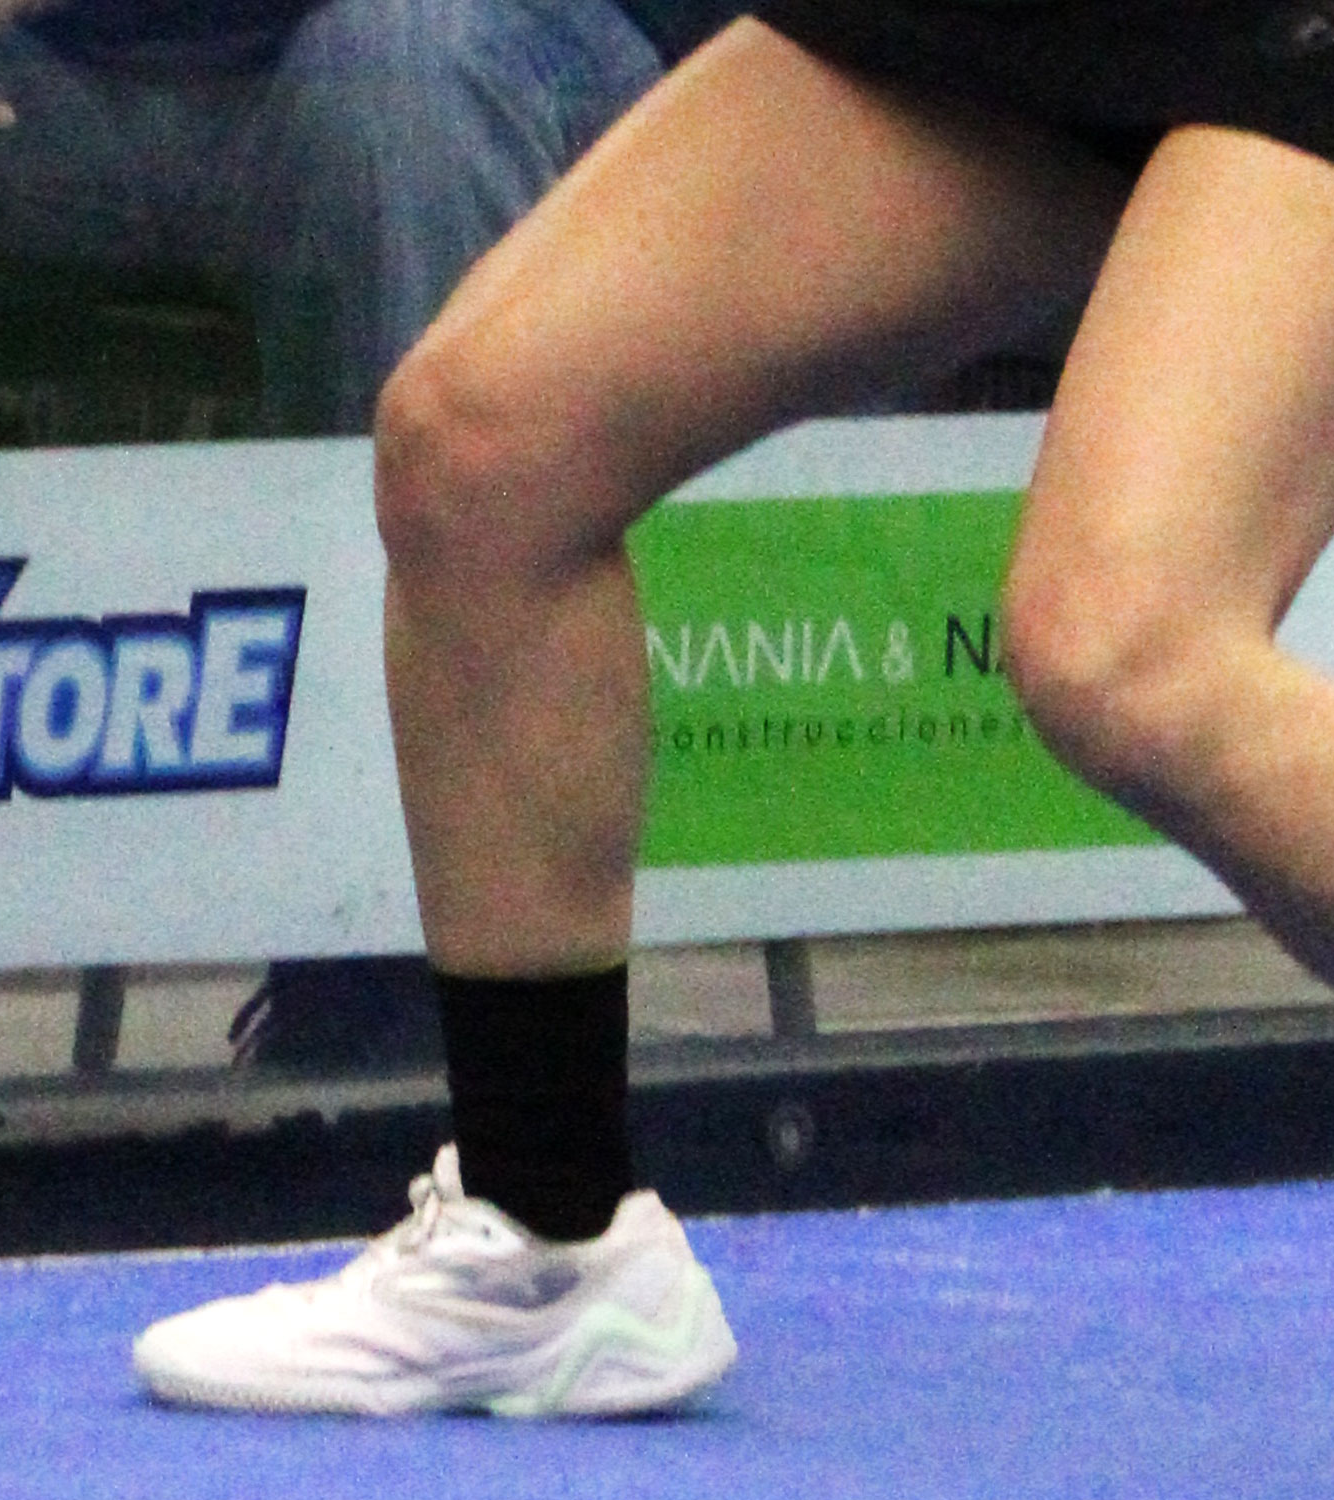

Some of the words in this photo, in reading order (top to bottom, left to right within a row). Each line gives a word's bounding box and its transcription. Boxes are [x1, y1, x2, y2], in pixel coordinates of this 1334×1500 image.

[645, 617, 865, 691] NANIA
[881, 619, 915, 685] &
[653, 706, 1025, 754] onstrucciones
